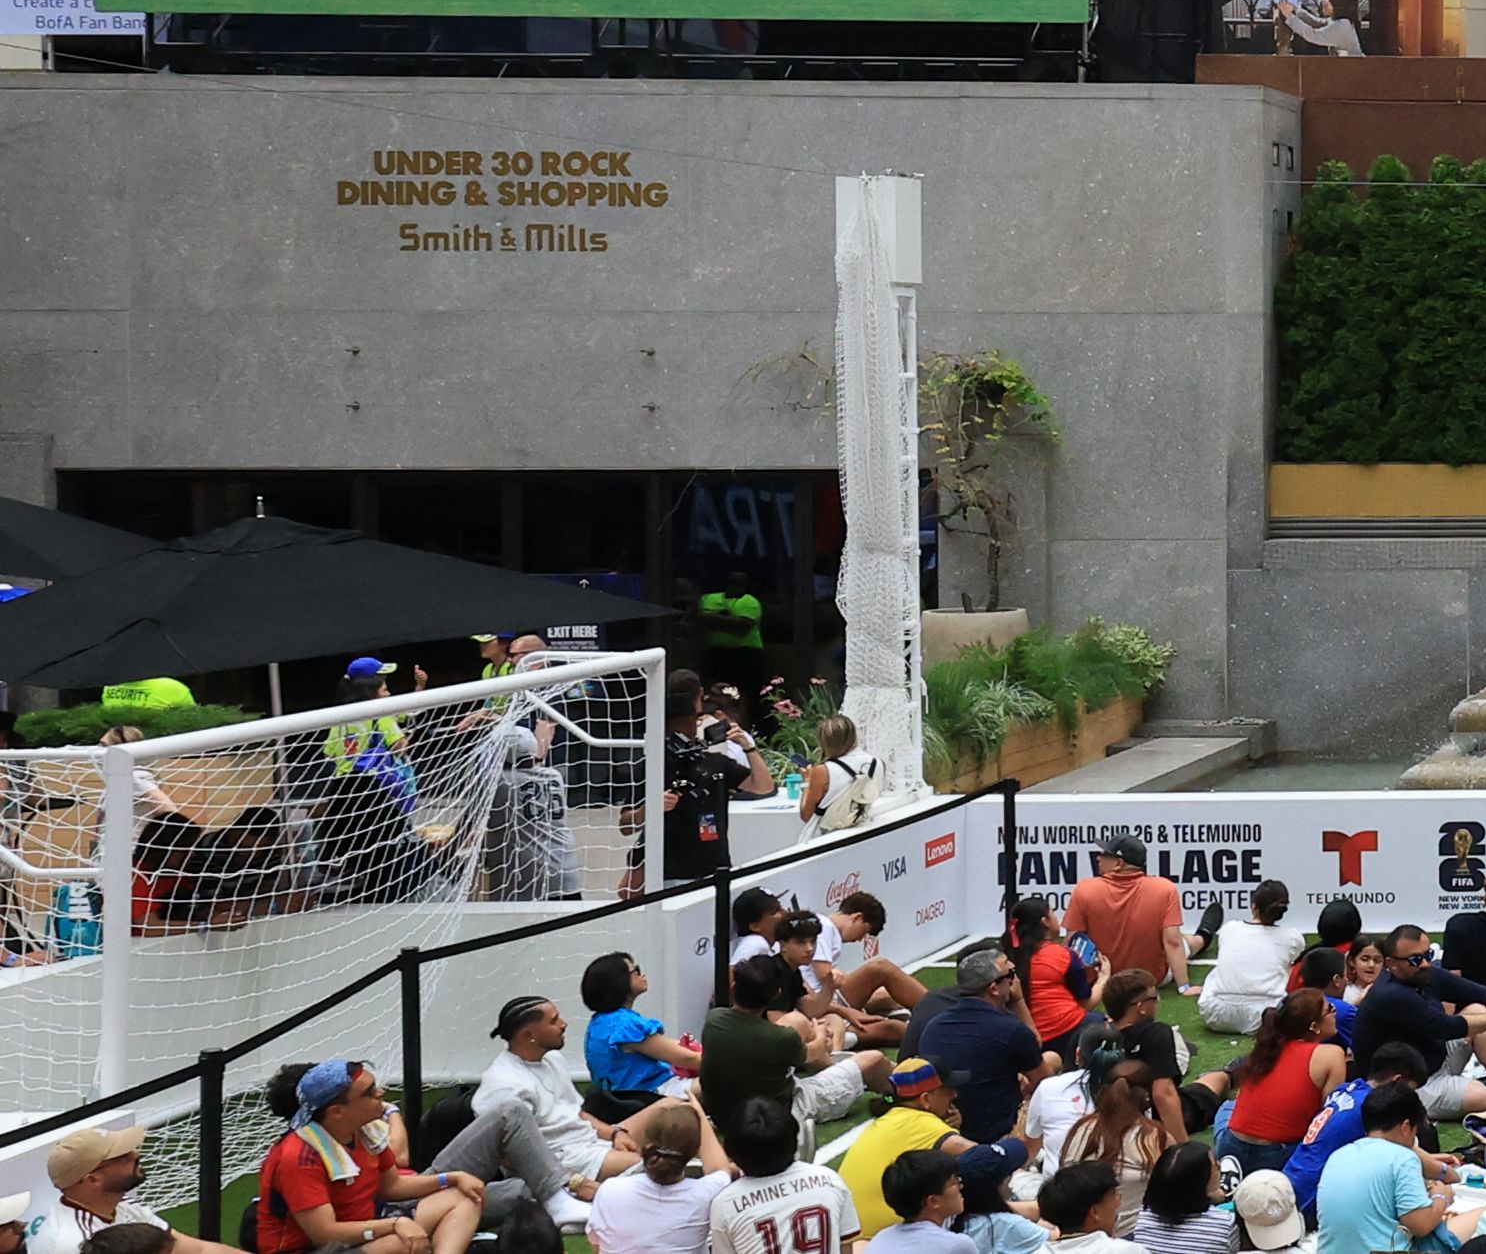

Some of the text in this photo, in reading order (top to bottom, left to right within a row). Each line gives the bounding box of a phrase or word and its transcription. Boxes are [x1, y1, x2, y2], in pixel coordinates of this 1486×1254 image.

[36, 16, 107, 29] BofA Fan
[374, 150, 632, 177] UNDER 30 ROCK
[337, 180, 669, 208] DINING & SHOPPING
[399, 223, 608, 253] Smith & Mills
[548, 625, 598, 638] EXIT HERE
[107, 688, 151, 702] SECURITY
[998, 824, 1262, 844] NNJ WORLD 26 & TELEMUNDO
[927, 840, 954, 862] Lenovo
[882, 856, 907, 882] VISA
[1452, 877, 1474, 887] FIFA
[1306, 892, 1395, 905] TELEMUNDO
[916, 900, 945, 927] DIAGEO
[733, 1174, 835, 1213] LAMINE YAMAL
[754, 1203, 831, 1254] 19
